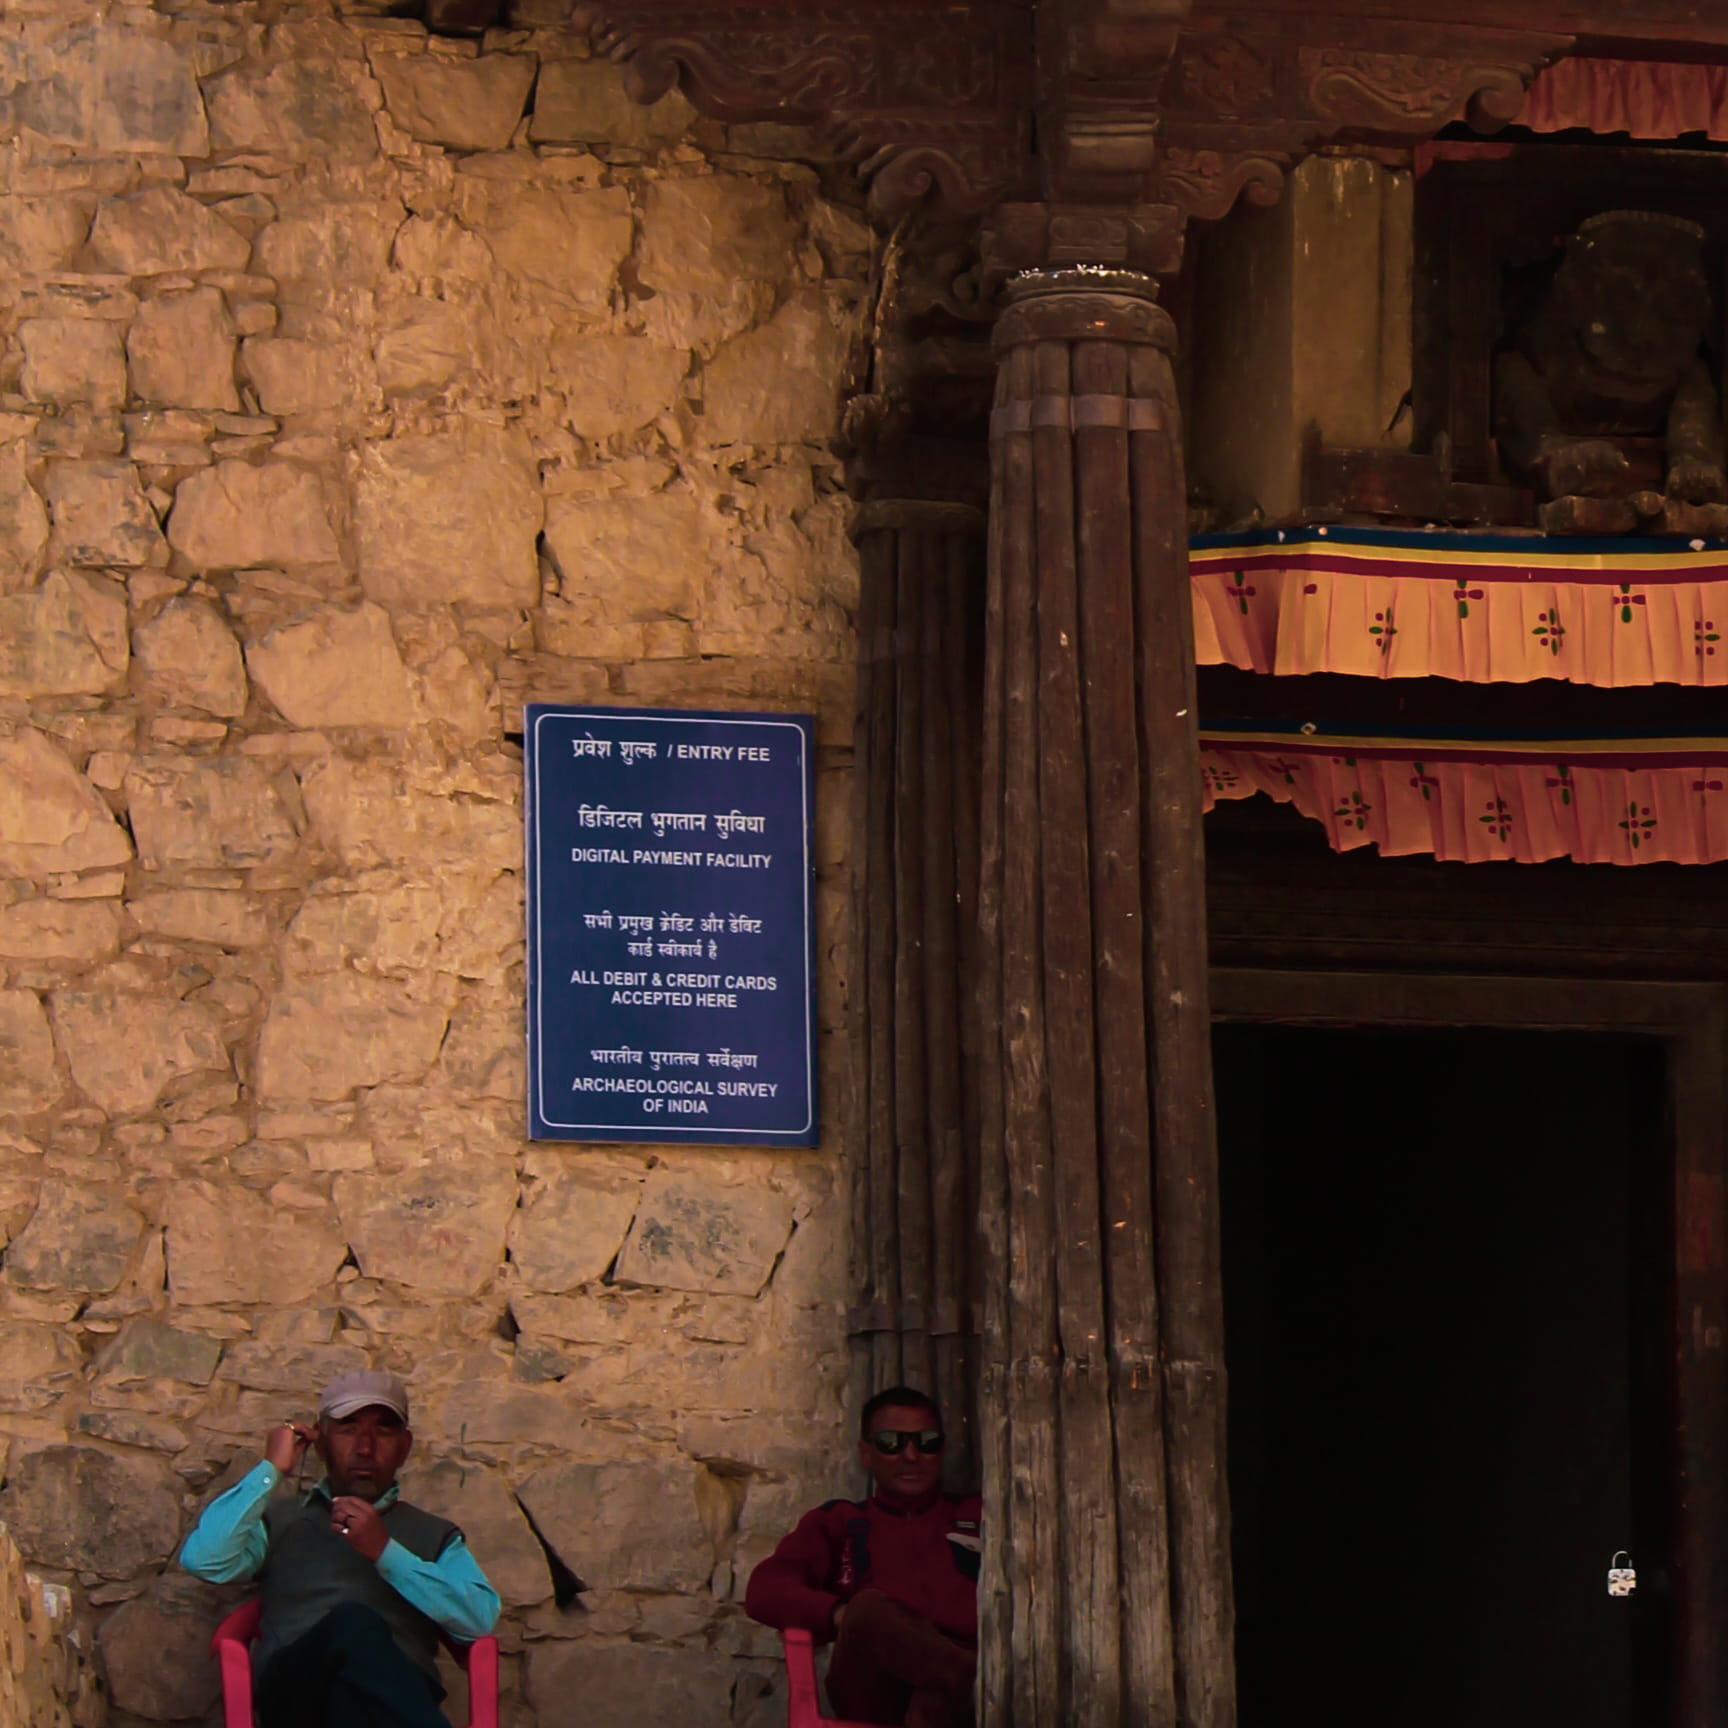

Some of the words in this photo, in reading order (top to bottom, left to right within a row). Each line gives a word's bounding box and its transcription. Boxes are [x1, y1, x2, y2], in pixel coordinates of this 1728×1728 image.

[571, 732, 613, 759] प्रवेश
[618, 742, 657, 766] शुल्क
[677, 745, 734, 761] ENTRY
[737, 747, 771, 762] FEE
[577, 804, 644, 829] डिजिटल
[650, 813, 708, 838] भुगतान
[713, 810, 766, 840] सुविधा
[571, 848, 630, 864] DIGITAL
[632, 850, 703, 867] PAYMENT
[706, 853, 772, 869] FACILITY
[583, 910, 614, 929] सभी
[617, 916, 655, 937] प्रमुख
[658, 911, 695, 932] क्रेडिट
[699, 912, 725, 933] और
[627, 937, 654, 958] कार्ड
[570, 970, 601, 985] ALL
[603, 971, 648, 986] DEBIT
[651, 973, 663, 987] &
[665, 973, 722, 989] CREDIT
[724, 976, 777, 991] CARDS
[611, 991, 693, 1007] ACCEPTED
[695, 993, 738, 1009] HERE
[590, 1046, 644, 1065] भारतीय
[648, 1052, 701, 1072] पुरातत्व
[705, 1048, 759, 1071] सर्वेक्षण
[571, 1078, 715, 1096] ARCHAEOLOGICAL
[716, 1082, 779, 1098] SURVEY
[642, 1099, 665, 1113] OF
[667, 1100, 709, 1114] INDIA
